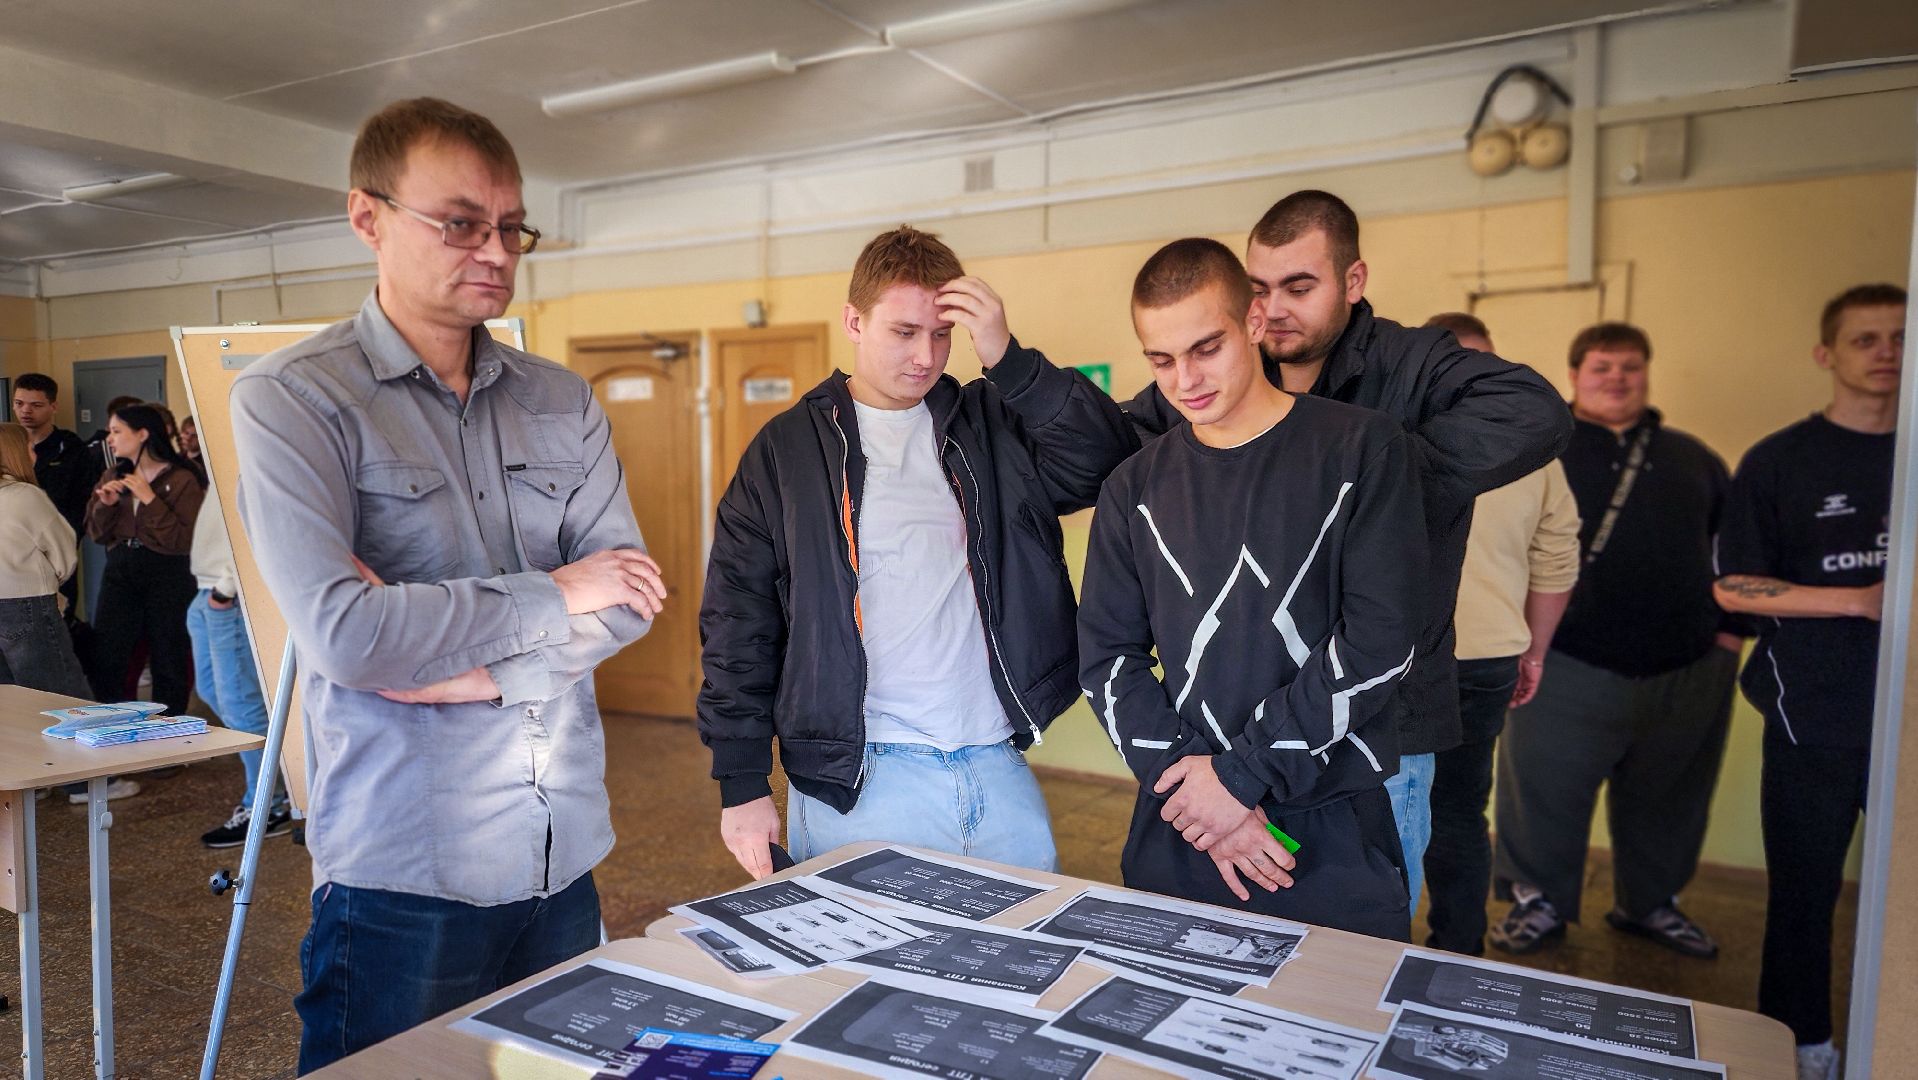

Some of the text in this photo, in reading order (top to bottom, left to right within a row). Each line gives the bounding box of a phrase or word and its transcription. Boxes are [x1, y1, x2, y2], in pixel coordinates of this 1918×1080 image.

[894, 962, 937, 974] сегодня
[971, 976, 1026, 991] Компания
[1491, 986, 1521, 996] Более
[1485, 1003, 1517, 1015] Более
[1564, 1001, 1596, 1010] Более
[1644, 1035, 1678, 1044] Более
[1595, 1037, 1671, 1055] Компания
[887, 1055, 939, 1071] сегодня
